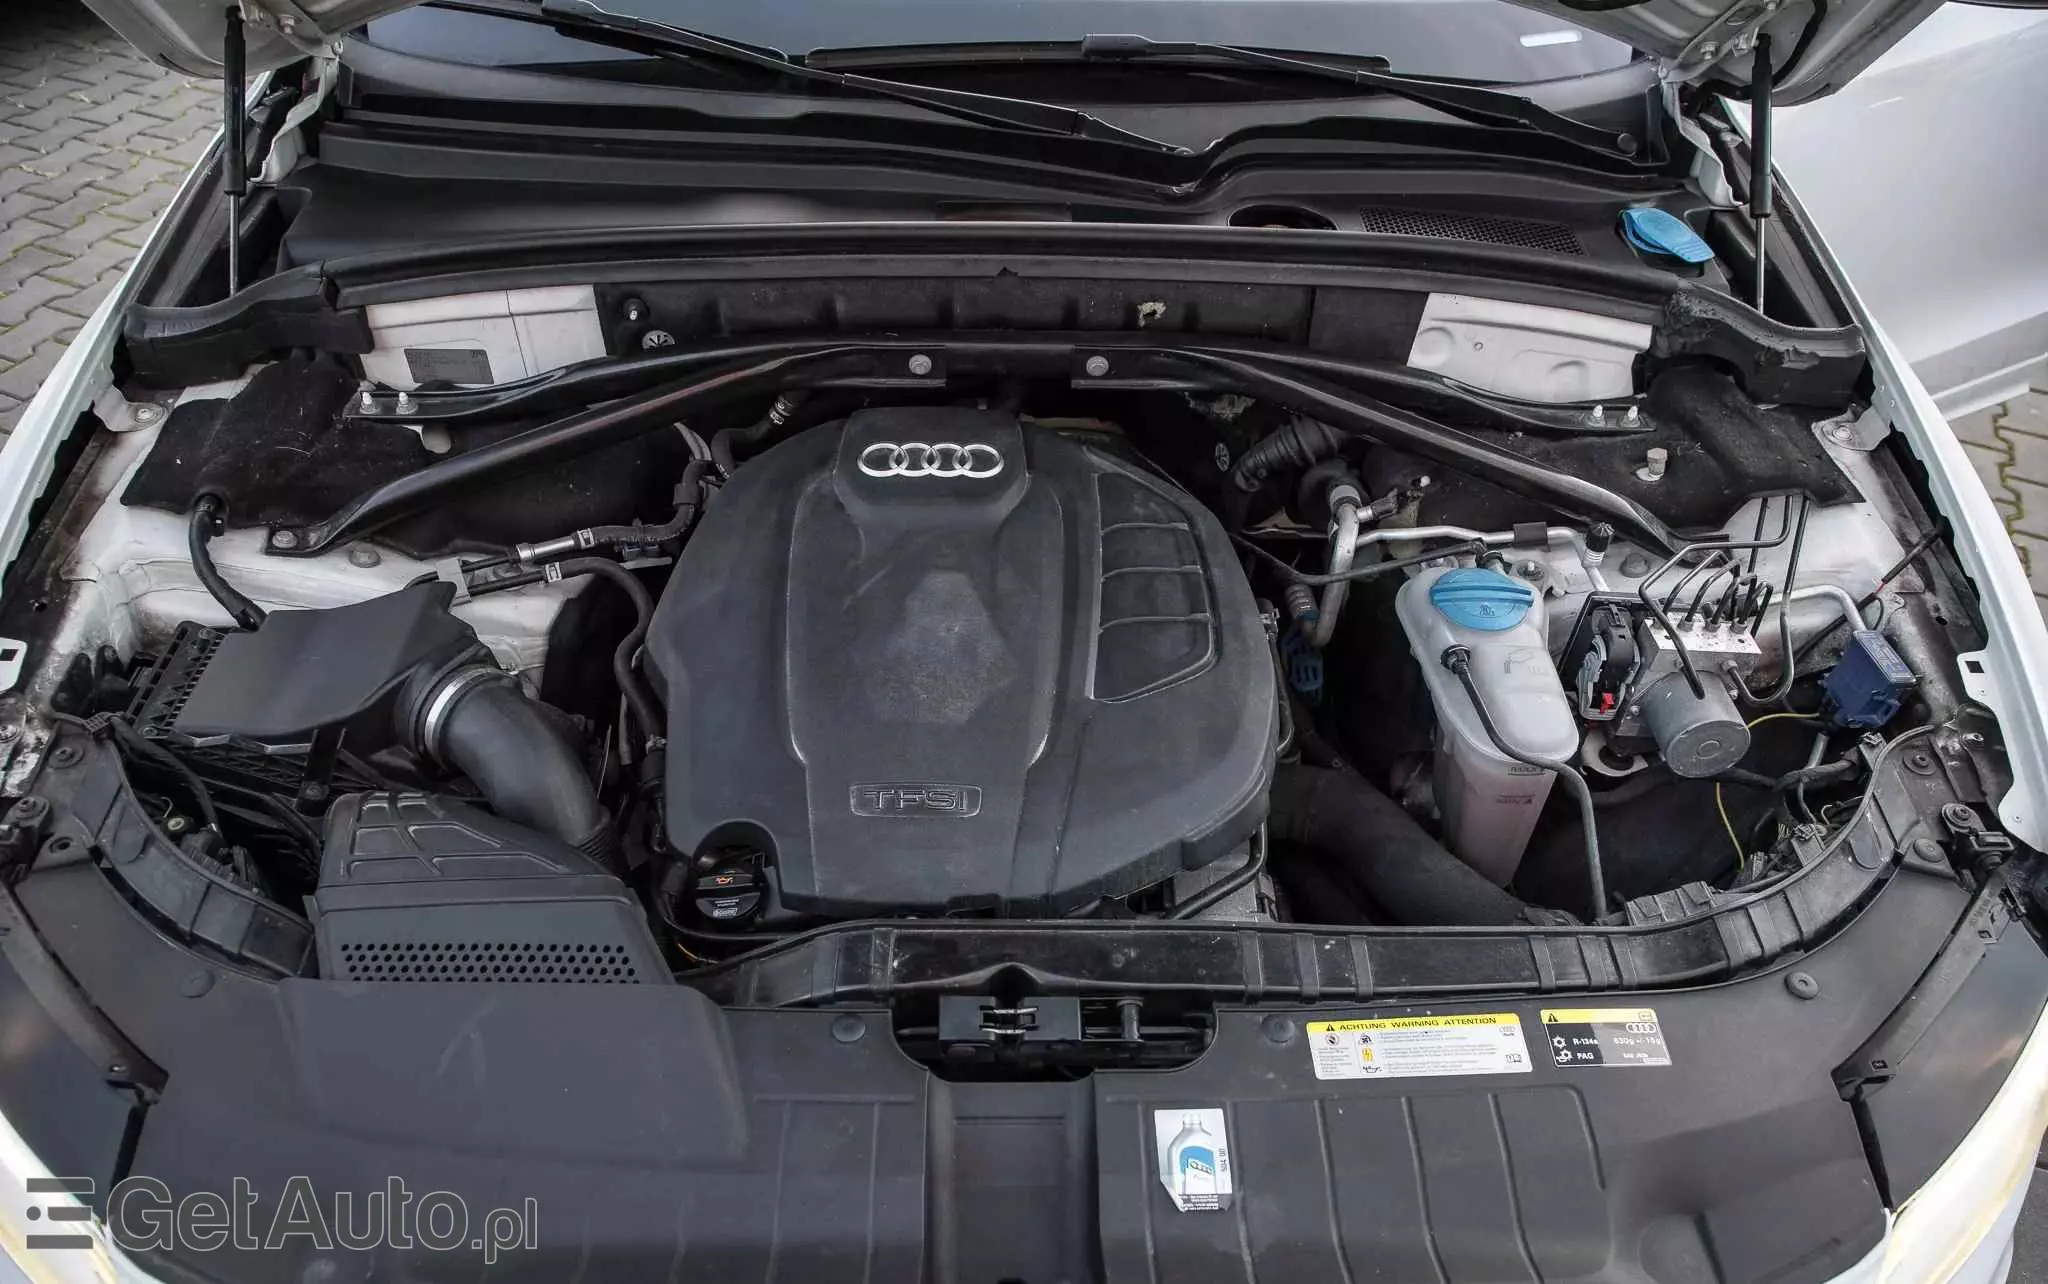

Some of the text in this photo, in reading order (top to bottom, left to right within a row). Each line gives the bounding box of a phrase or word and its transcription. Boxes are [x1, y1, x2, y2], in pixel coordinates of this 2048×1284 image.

[863, 788, 968, 812] TFSI
[1339, 1017, 1497, 1032] ACHTUNG WARNING ATTENTION
